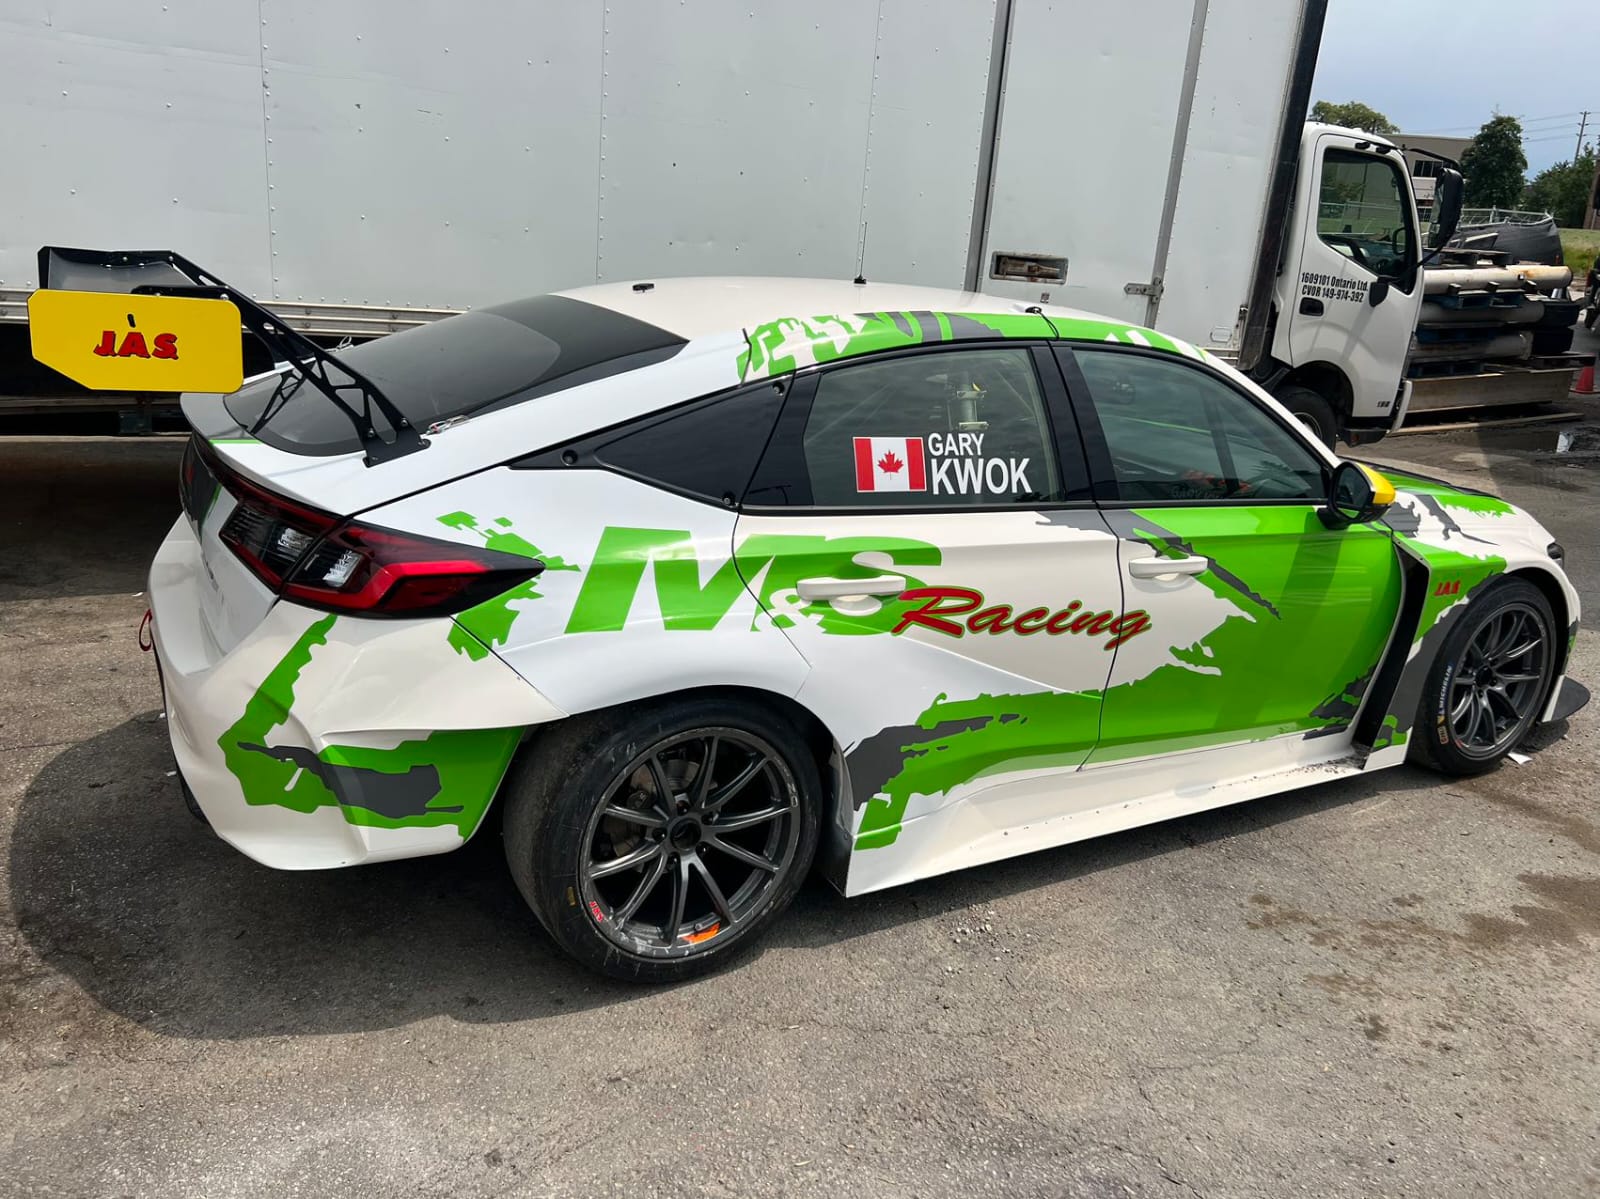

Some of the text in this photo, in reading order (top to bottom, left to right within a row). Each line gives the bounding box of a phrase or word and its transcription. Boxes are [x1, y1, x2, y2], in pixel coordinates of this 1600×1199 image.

[1301, 272, 1369, 291] 1609101 Ontario Ltd.
[1302, 285, 1364, 303] CVOR 149-974-392
[93, 330, 179, 360] JAS
[928, 433, 984, 456] GARY
[931, 458, 1032, 495] KWOK
[891, 584, 1152, 651] Racing
[1439, 665, 1453, 709] MICHELIN
